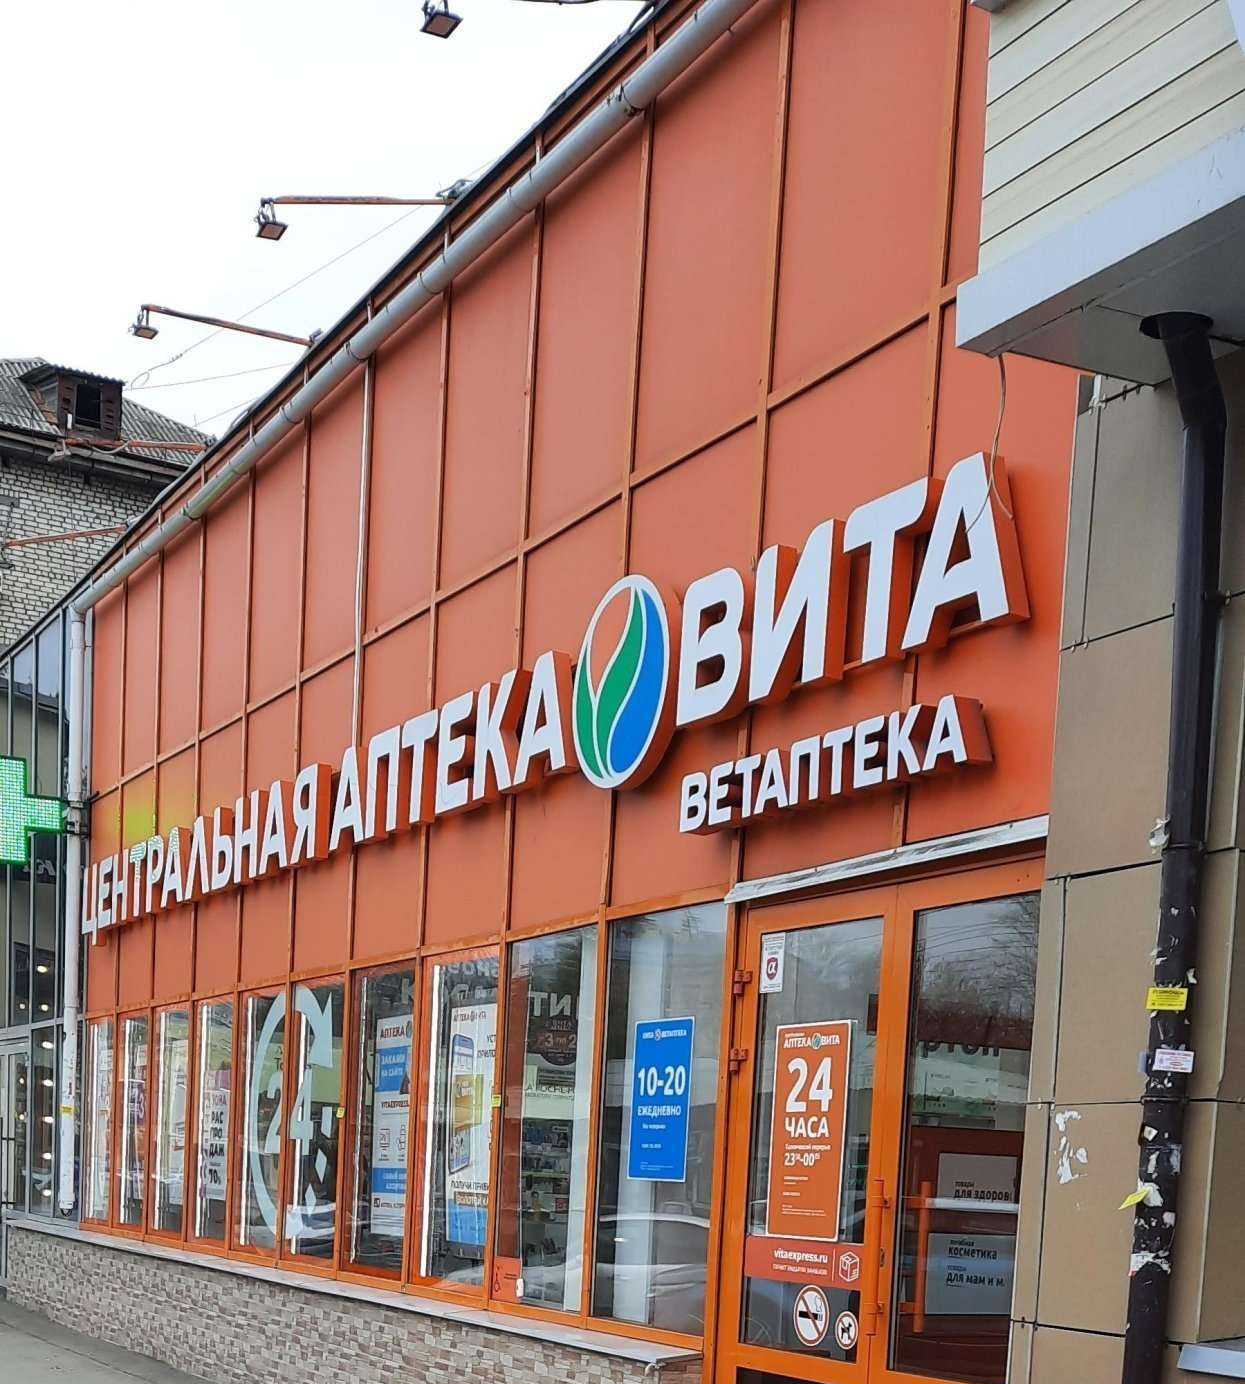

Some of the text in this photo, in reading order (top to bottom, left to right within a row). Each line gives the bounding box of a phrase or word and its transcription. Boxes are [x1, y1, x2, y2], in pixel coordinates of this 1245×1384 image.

[676, 451, 1010, 727] ВИТА
[679, 694, 968, 833] ВЕТАПТЕКА
[81, 650, 566, 946] ЦЕНТРАЛЬНАЯ АПТЕКА
[783, 1034, 841, 1049] АПТЕКА ВИТА
[637, 1064, 687, 1097] 10-20
[786, 1056, 834, 1114] 24
[637, 1104, 682, 1119] ЕЖЕДНЕВНО
[784, 1116, 830, 1138] ЧАСА
[774, 1248, 829, 1264] vitaexpress.ru
[948, 1246, 998, 1260] косметика
